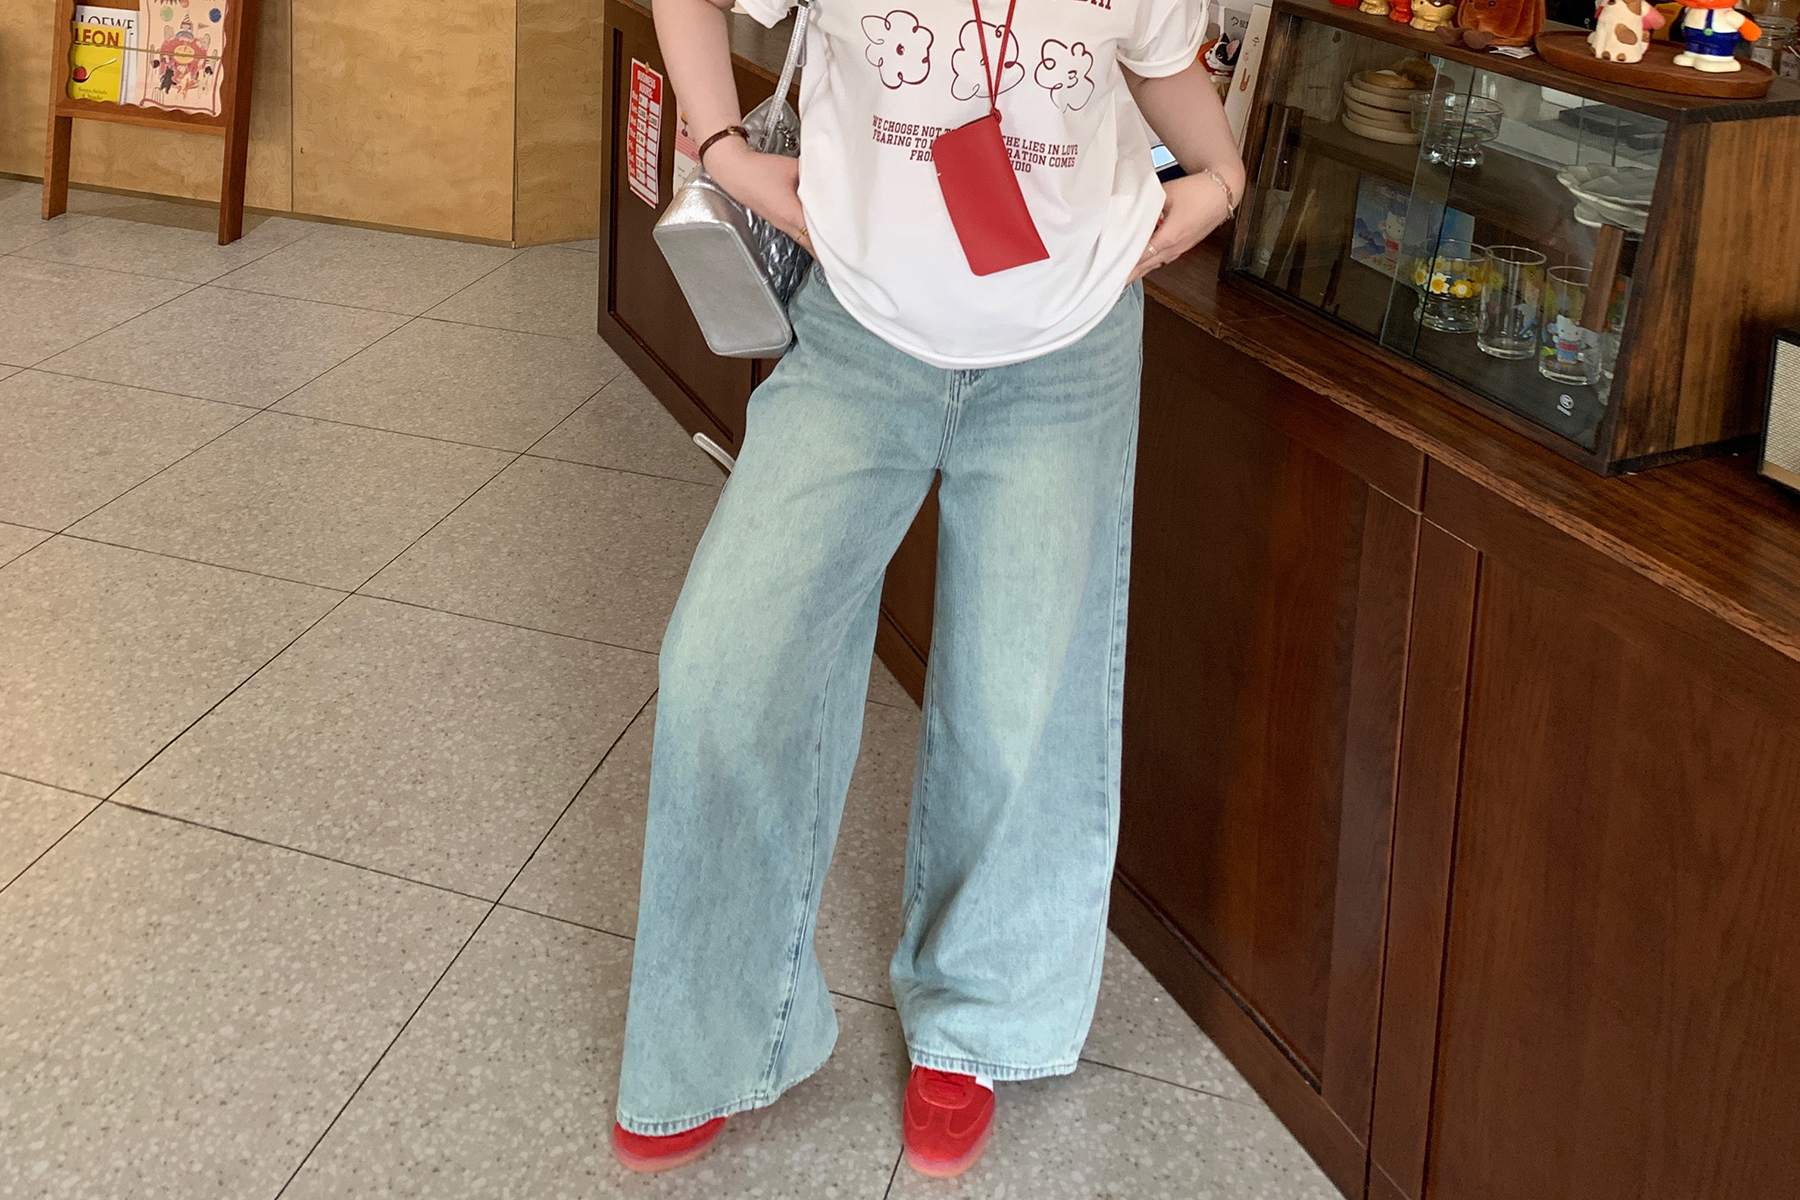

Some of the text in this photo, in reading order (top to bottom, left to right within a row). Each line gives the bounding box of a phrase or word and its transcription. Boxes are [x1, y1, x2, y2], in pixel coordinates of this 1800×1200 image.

[73, 27, 119, 48] LEON
[872, 114, 883, 130] WE
[882, 119, 920, 136] CHOOSE
[921, 125, 943, 139] NOT
[1022, 139, 1046, 154] LIES
[1047, 144, 1061, 156] IN
[1061, 143, 1079, 156] LOVE
[872, 129, 912, 148] FEARING
[914, 137, 928, 149] TO
[1048, 156, 1076, 169] COMES
[909, 149, 935, 162] FRO
